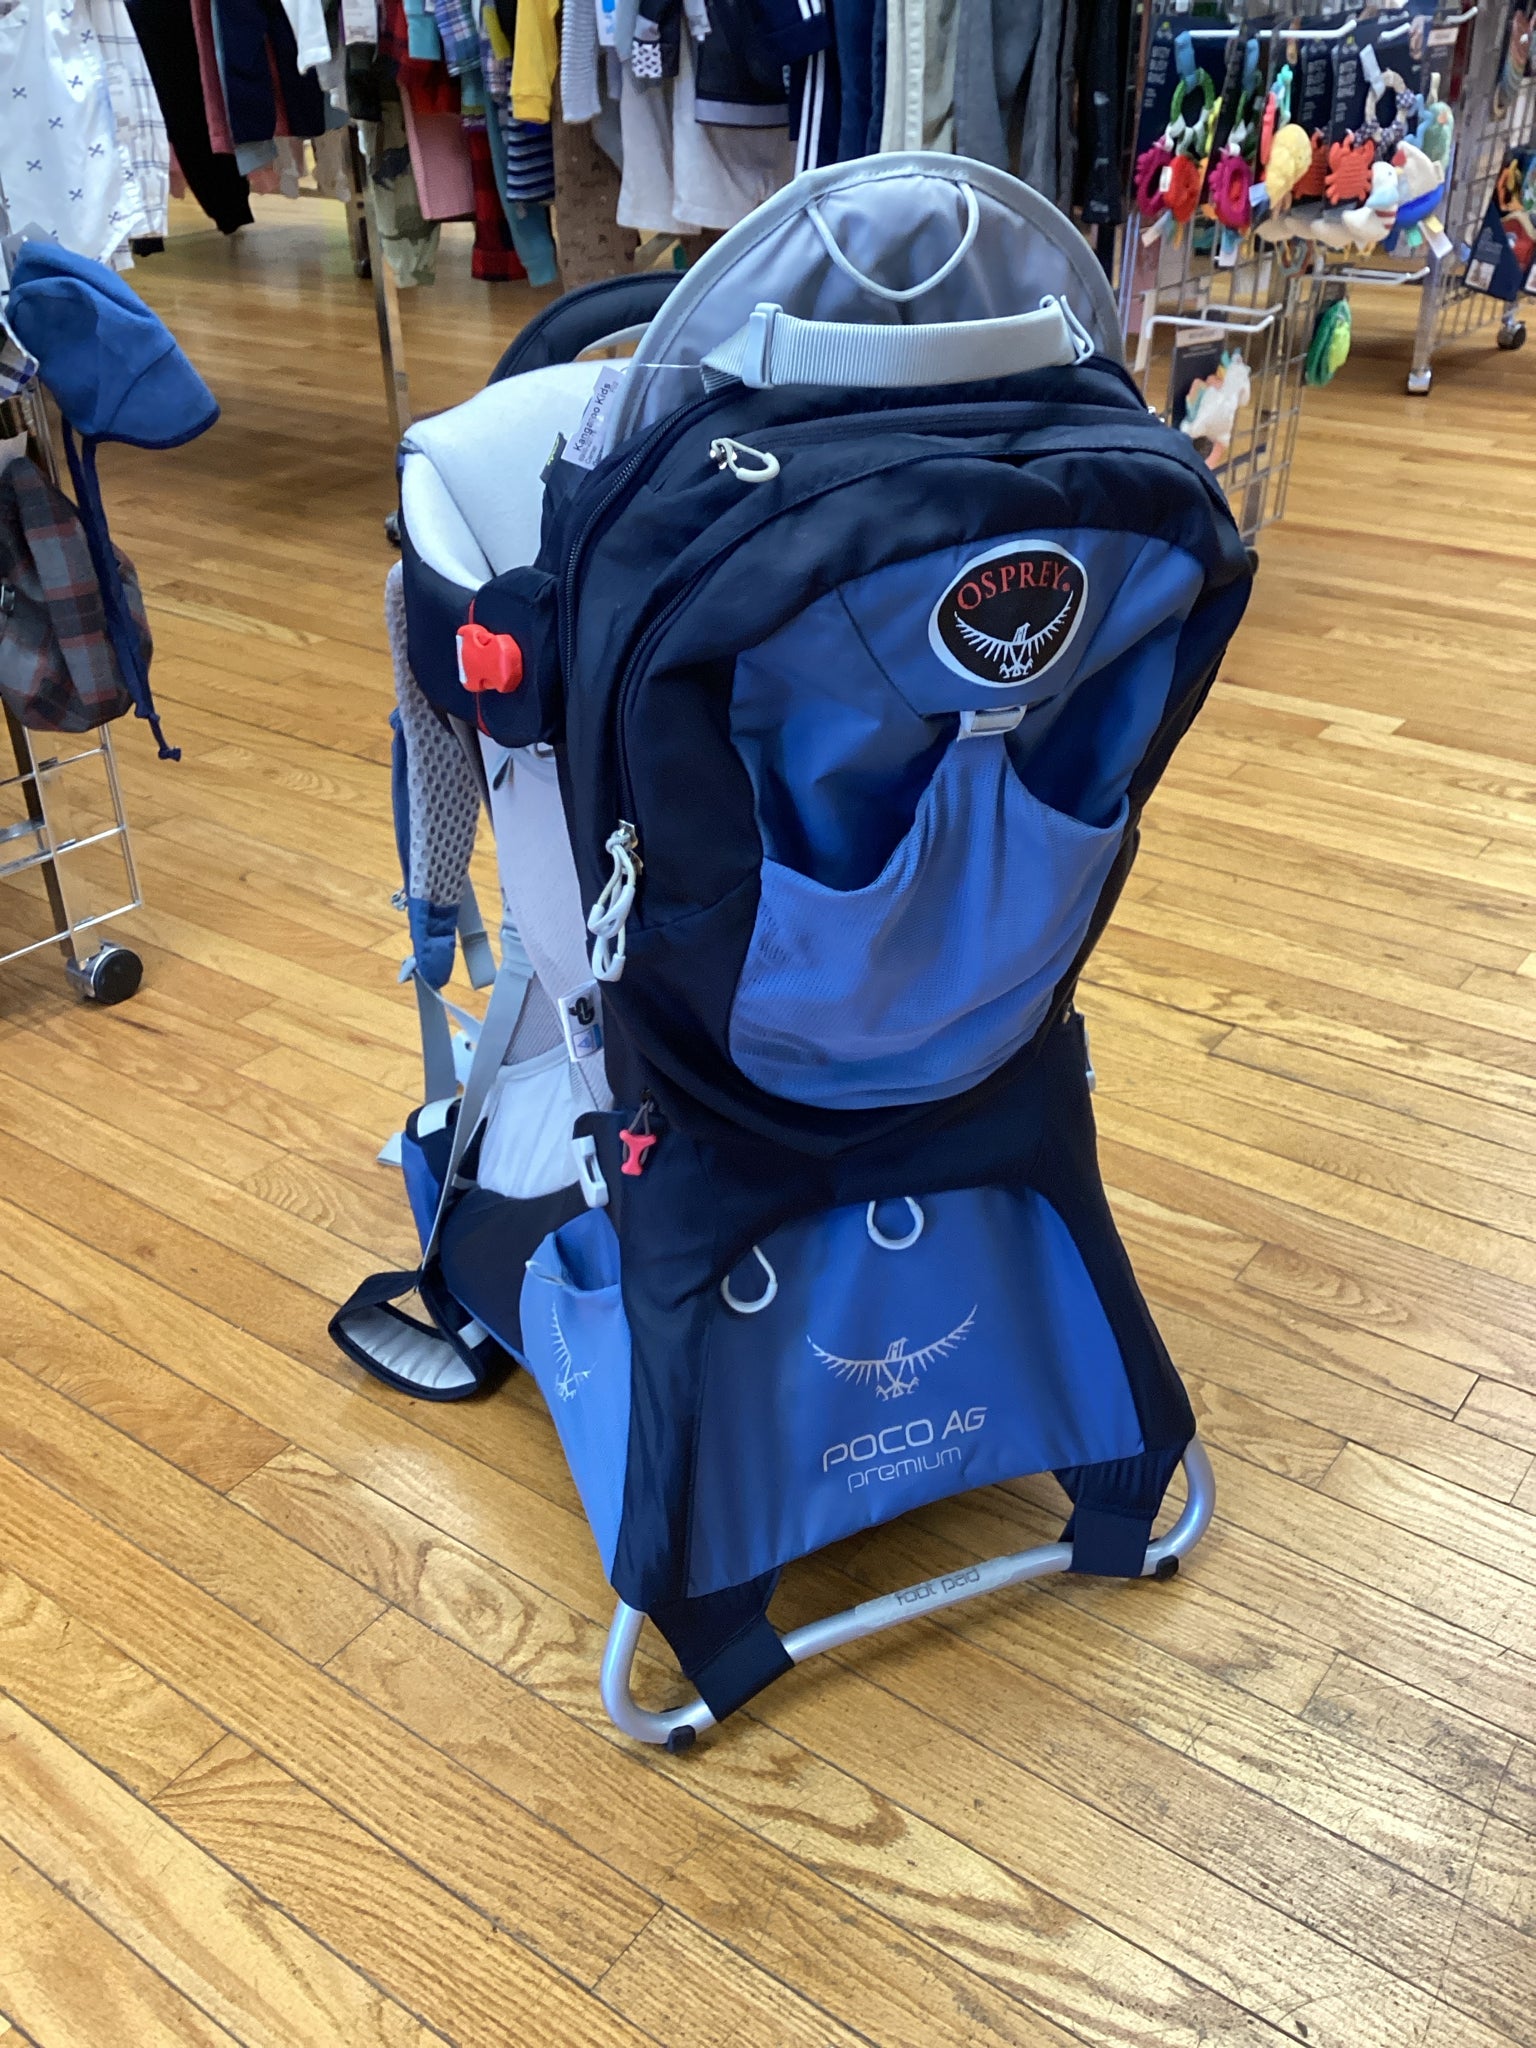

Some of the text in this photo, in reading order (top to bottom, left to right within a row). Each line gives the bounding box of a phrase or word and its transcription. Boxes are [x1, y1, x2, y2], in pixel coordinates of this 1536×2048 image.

[573, 405, 602, 452] Kangaroo
[595, 382, 611, 405] Kids
[957, 560, 1069, 610] OSPREY
[822, 1406, 988, 1472] POCO AG
[847, 1446, 962, 1494] premium
[941, 1567, 980, 1593] pad
